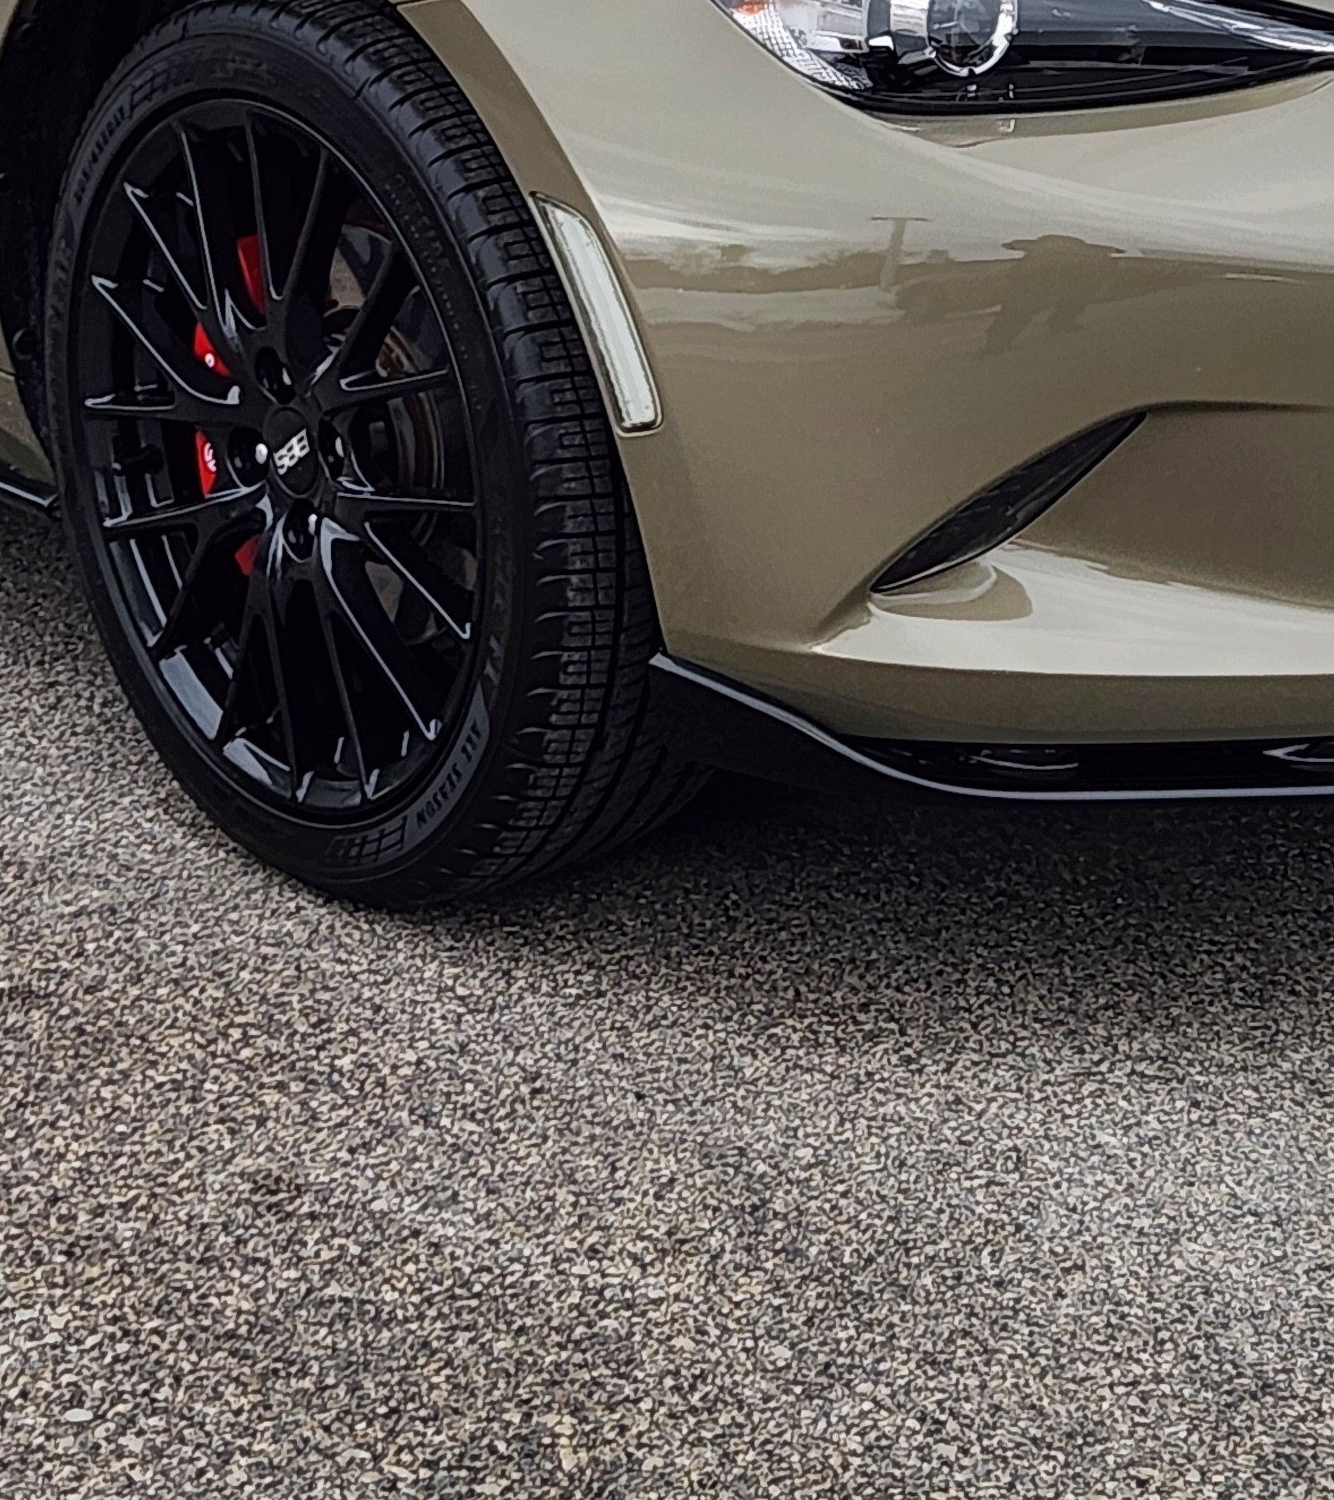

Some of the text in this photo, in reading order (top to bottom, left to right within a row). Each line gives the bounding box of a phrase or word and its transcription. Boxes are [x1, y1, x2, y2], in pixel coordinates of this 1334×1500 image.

[273, 428, 309, 475] BBS
[415, 720, 482, 829] ALL SEASON
